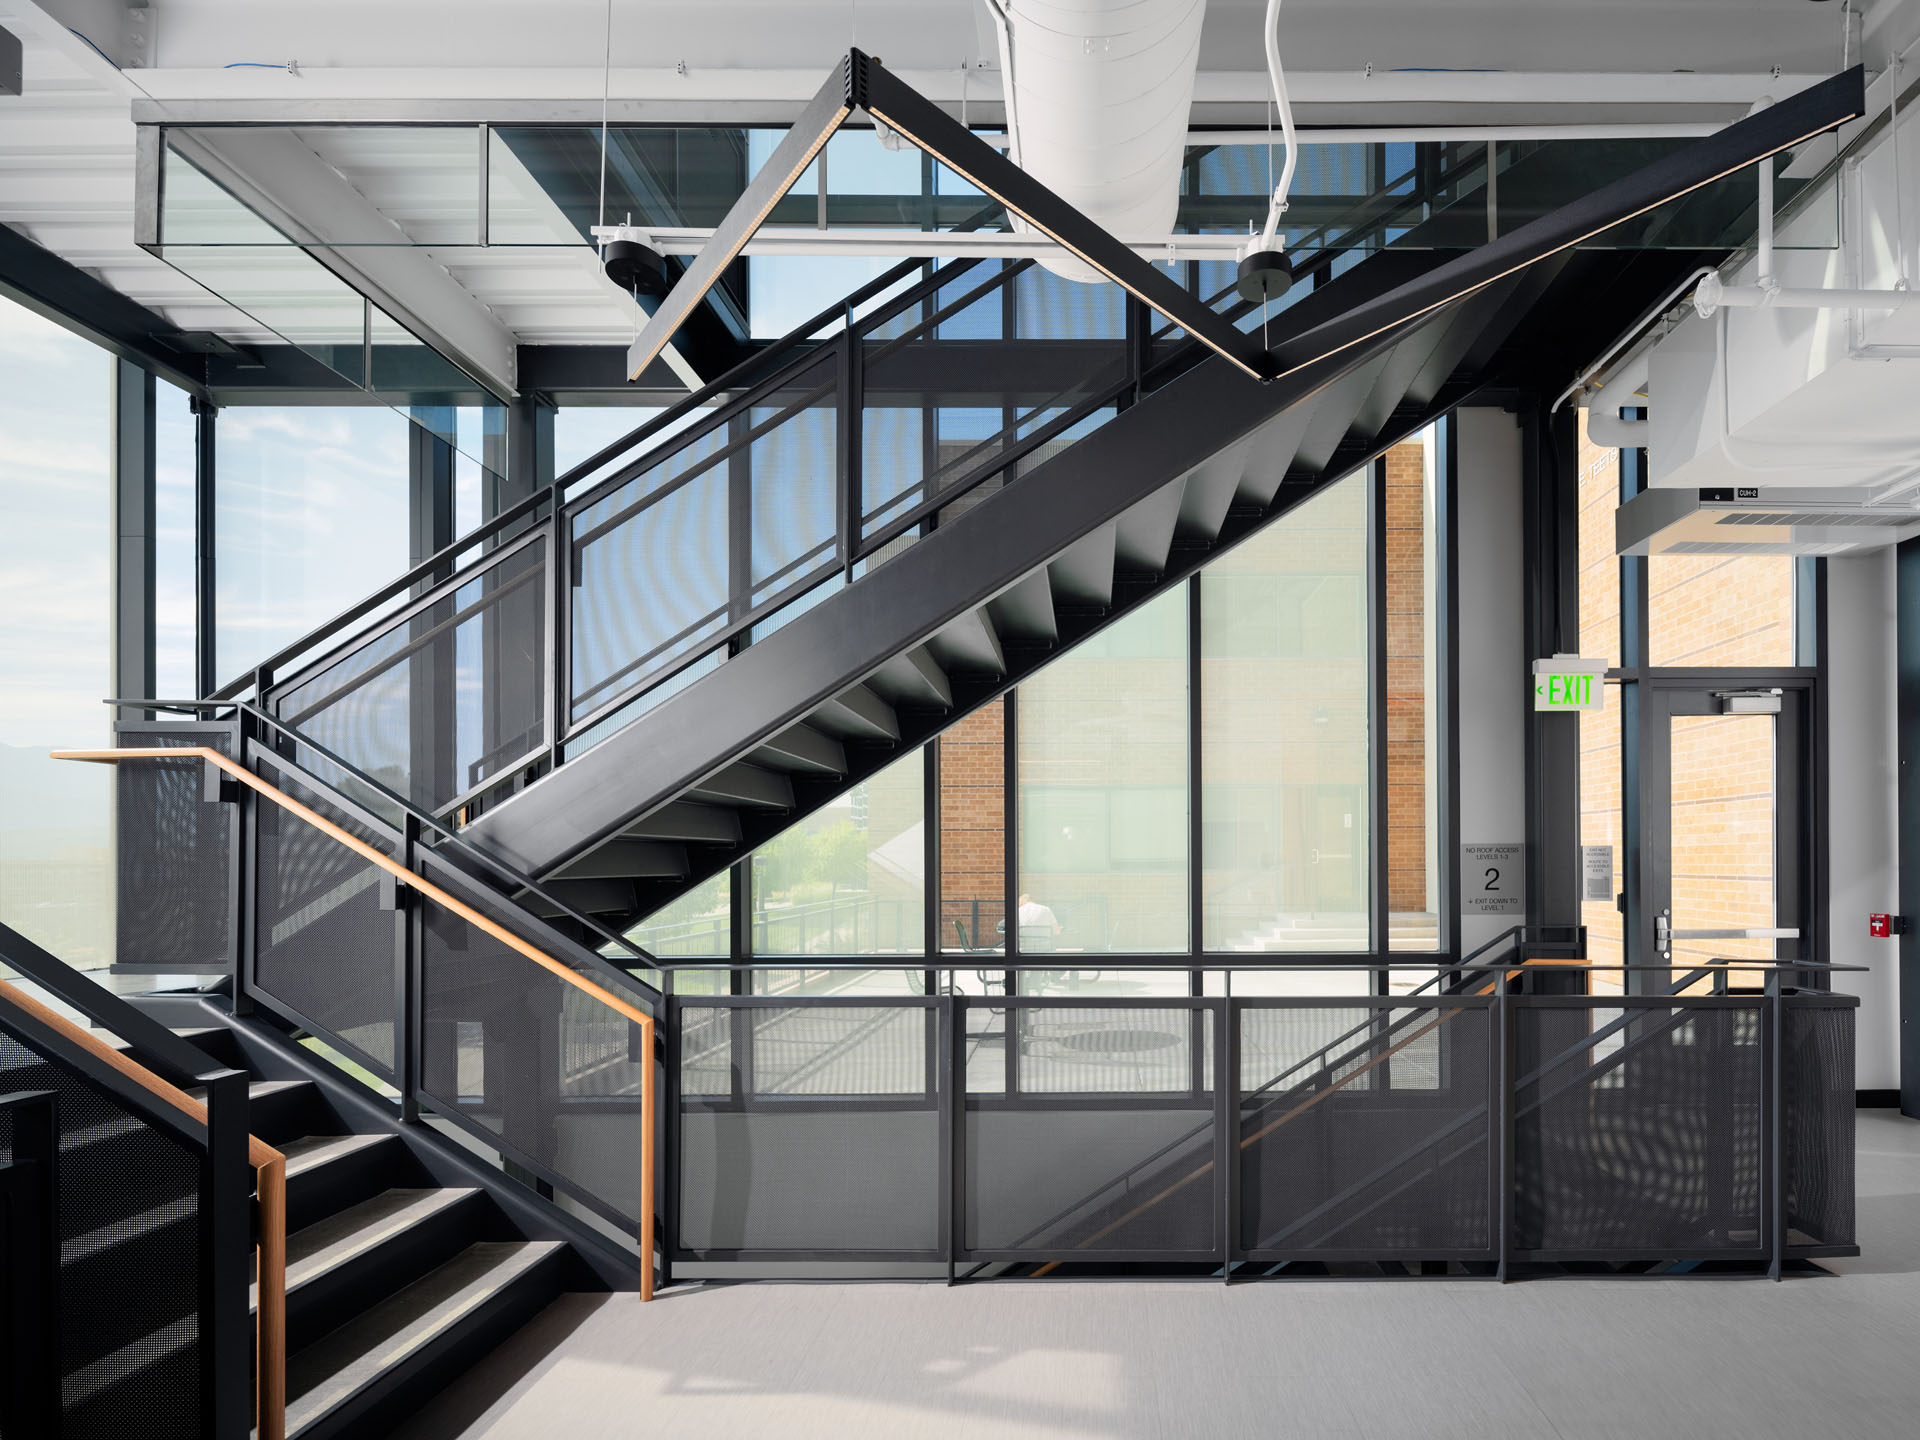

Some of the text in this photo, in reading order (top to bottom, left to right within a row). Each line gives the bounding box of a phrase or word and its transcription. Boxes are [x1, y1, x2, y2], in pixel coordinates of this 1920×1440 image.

[1739, 489, 1757, 497] CUH-2
[1548, 675, 1594, 705] EXIT
[1484, 867, 1500, 890] 2
